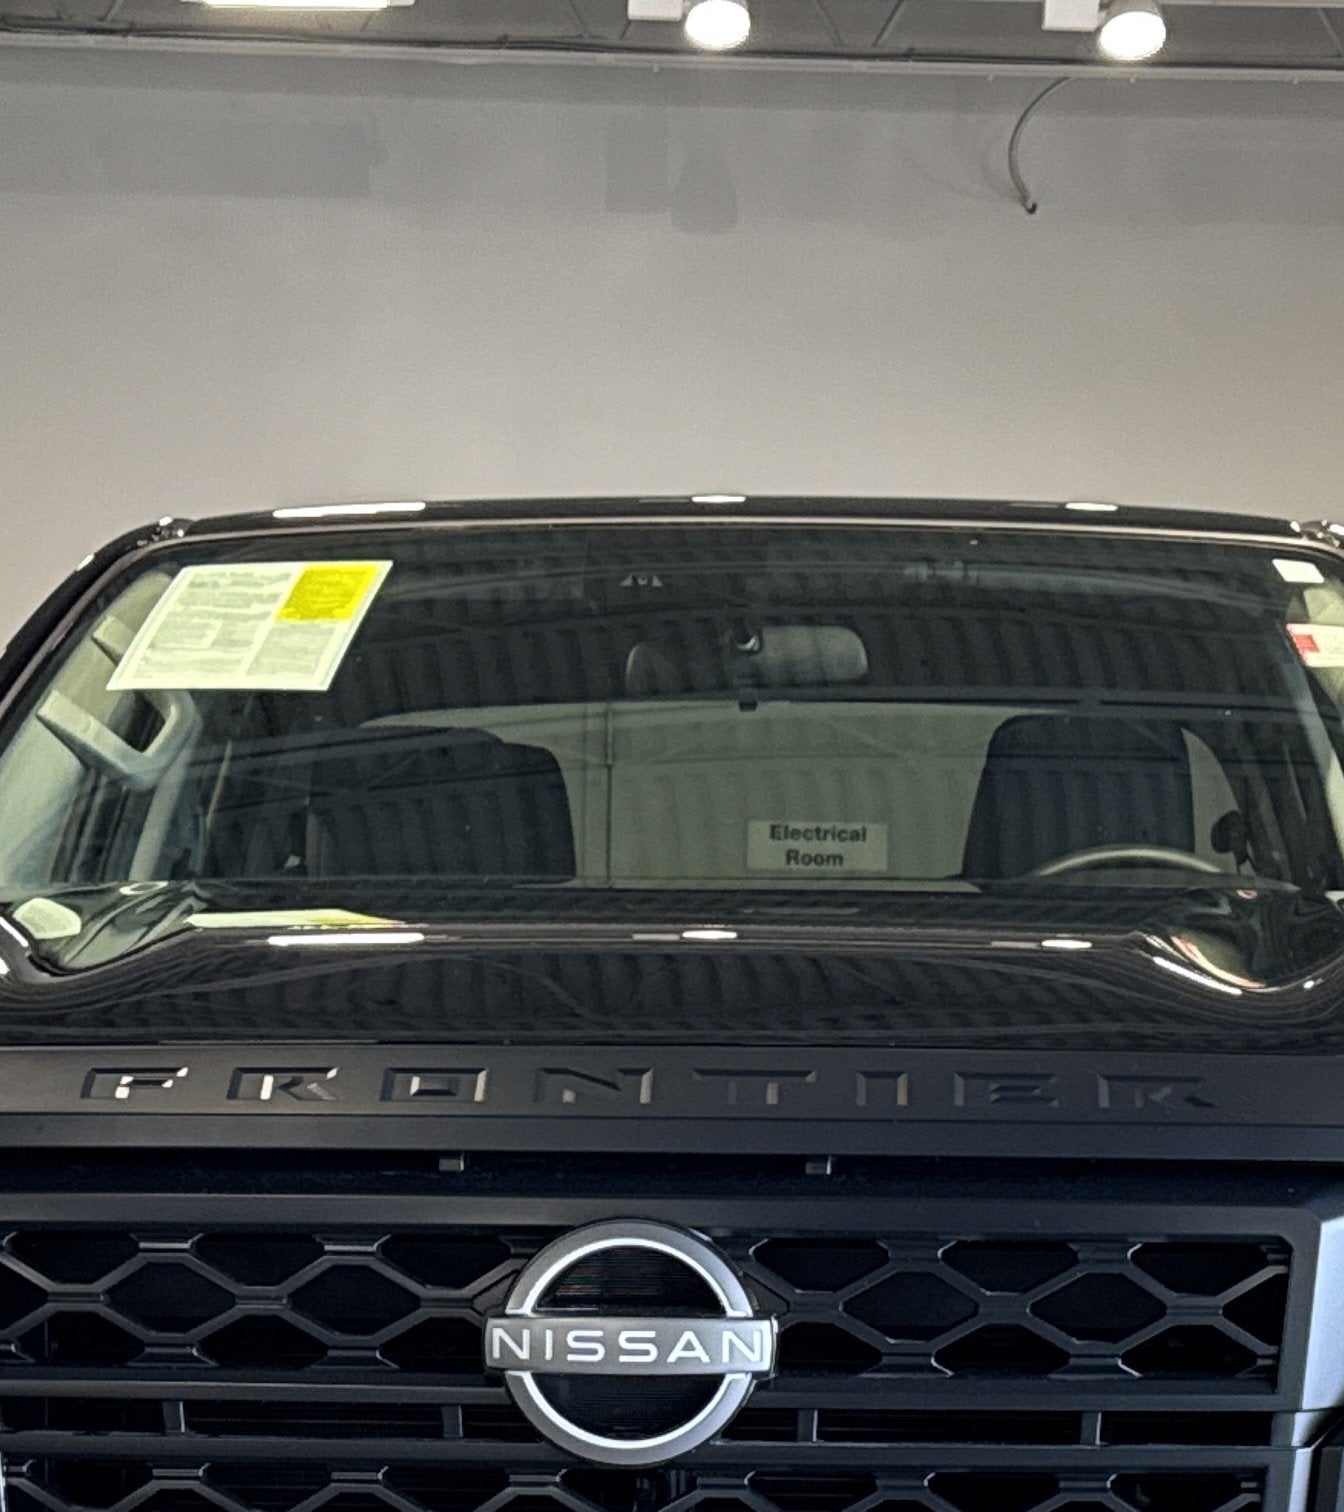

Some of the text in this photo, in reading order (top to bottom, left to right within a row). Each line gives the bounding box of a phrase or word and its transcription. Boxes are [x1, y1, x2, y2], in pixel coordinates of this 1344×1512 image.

[769, 824, 867, 842] Electrical
[785, 849, 844, 866] Room
[80, 1066, 1218, 1109] FRONTIER
[492, 1327, 762, 1364] NISSAN
